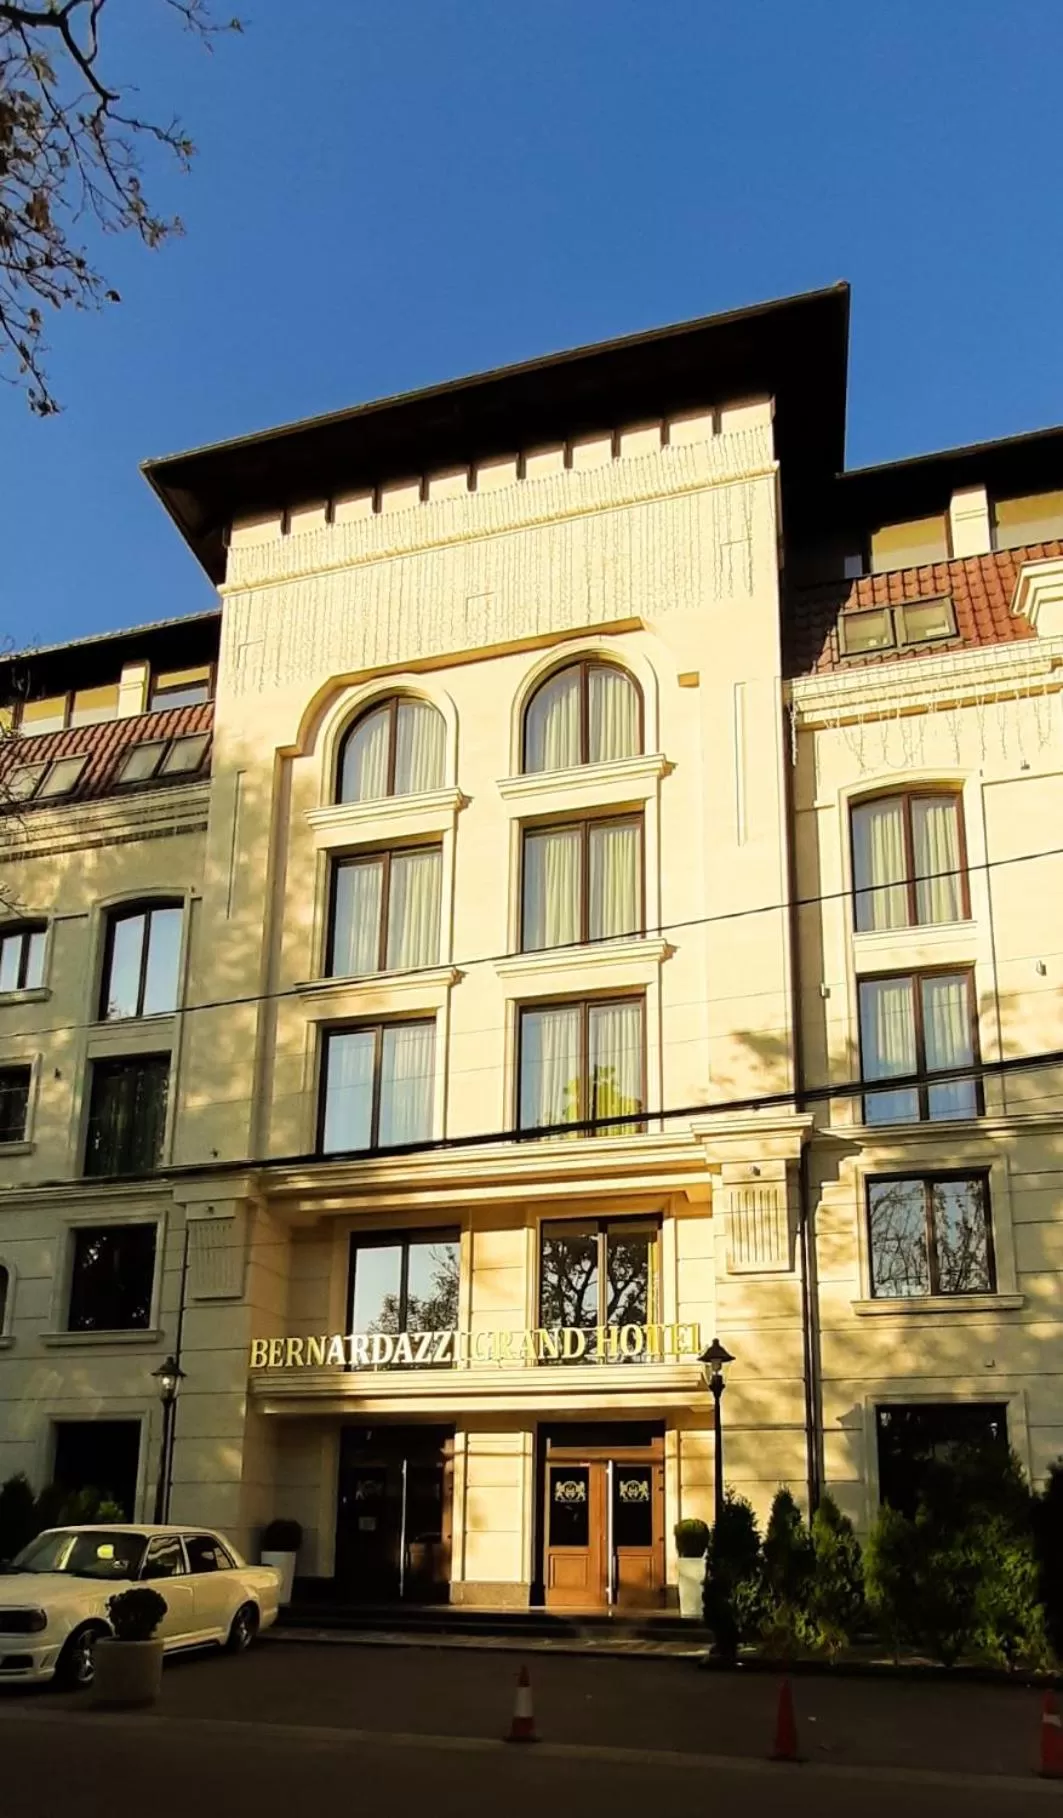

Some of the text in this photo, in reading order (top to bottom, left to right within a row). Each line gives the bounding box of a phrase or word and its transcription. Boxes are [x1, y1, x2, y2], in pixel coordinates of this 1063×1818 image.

[249, 1323, 703, 1367] BERNARDAZZI GRAND HOTEL
